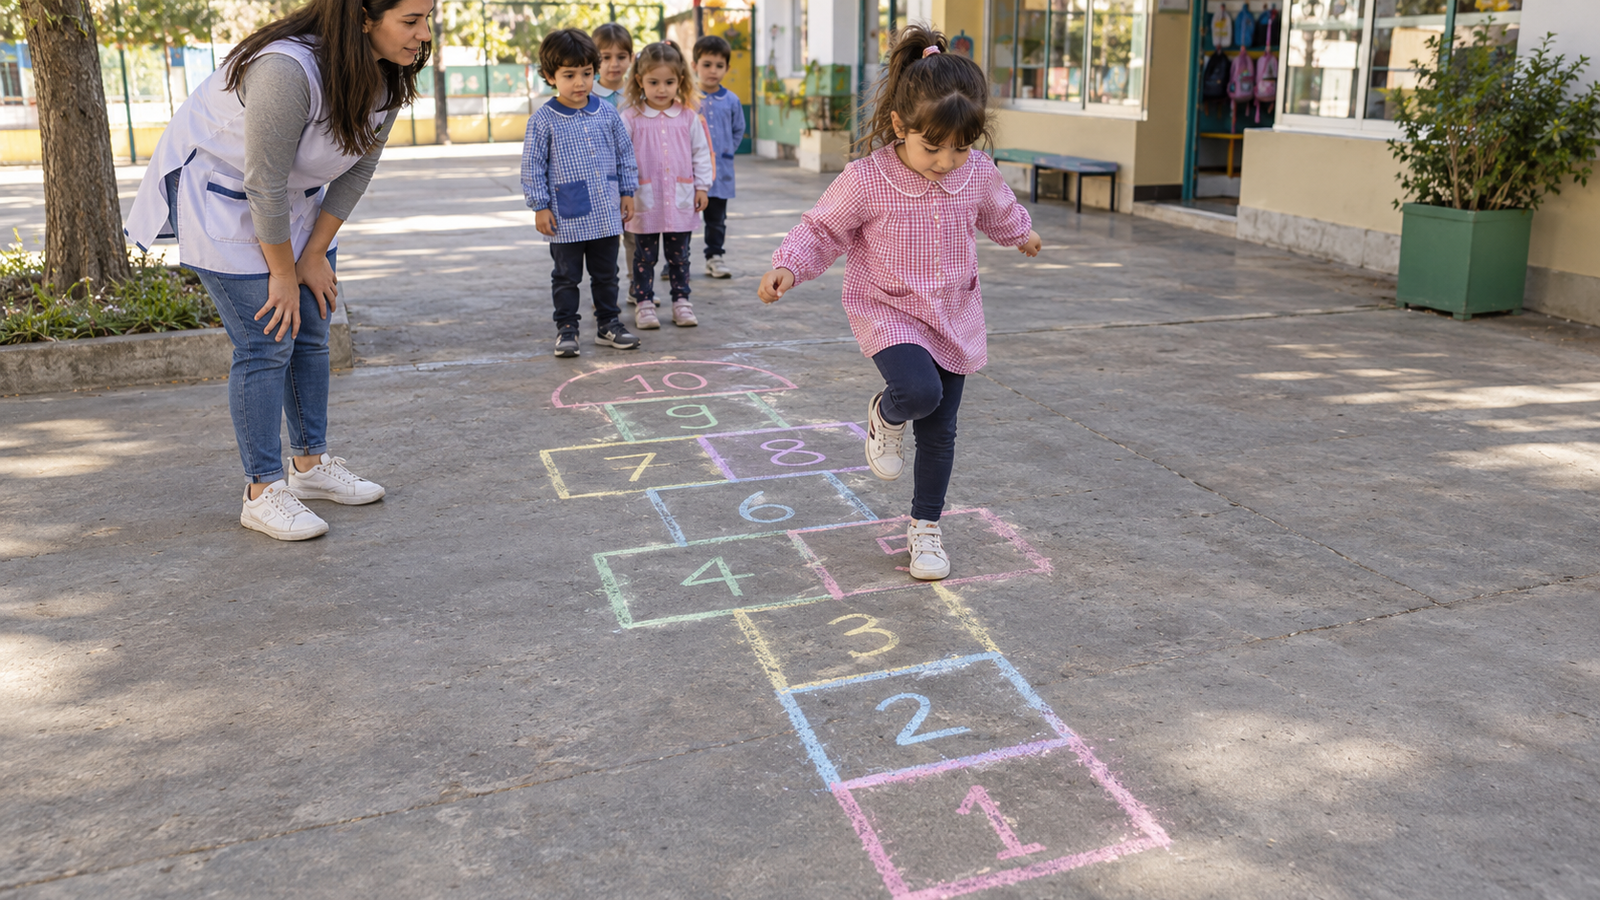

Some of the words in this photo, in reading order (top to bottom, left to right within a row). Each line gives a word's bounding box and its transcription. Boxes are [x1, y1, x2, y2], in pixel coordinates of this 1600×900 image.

[624, 371, 708, 395] 10
[665, 404, 719, 430] 9
[604, 452, 657, 482] 7
[759, 438, 827, 467] 8
[739, 491, 796, 523] 6
[680, 556, 755, 597] 4
[828, 613, 900, 657] 3
[875, 692, 971, 746] 2
[955, 785, 1047, 861] 1
